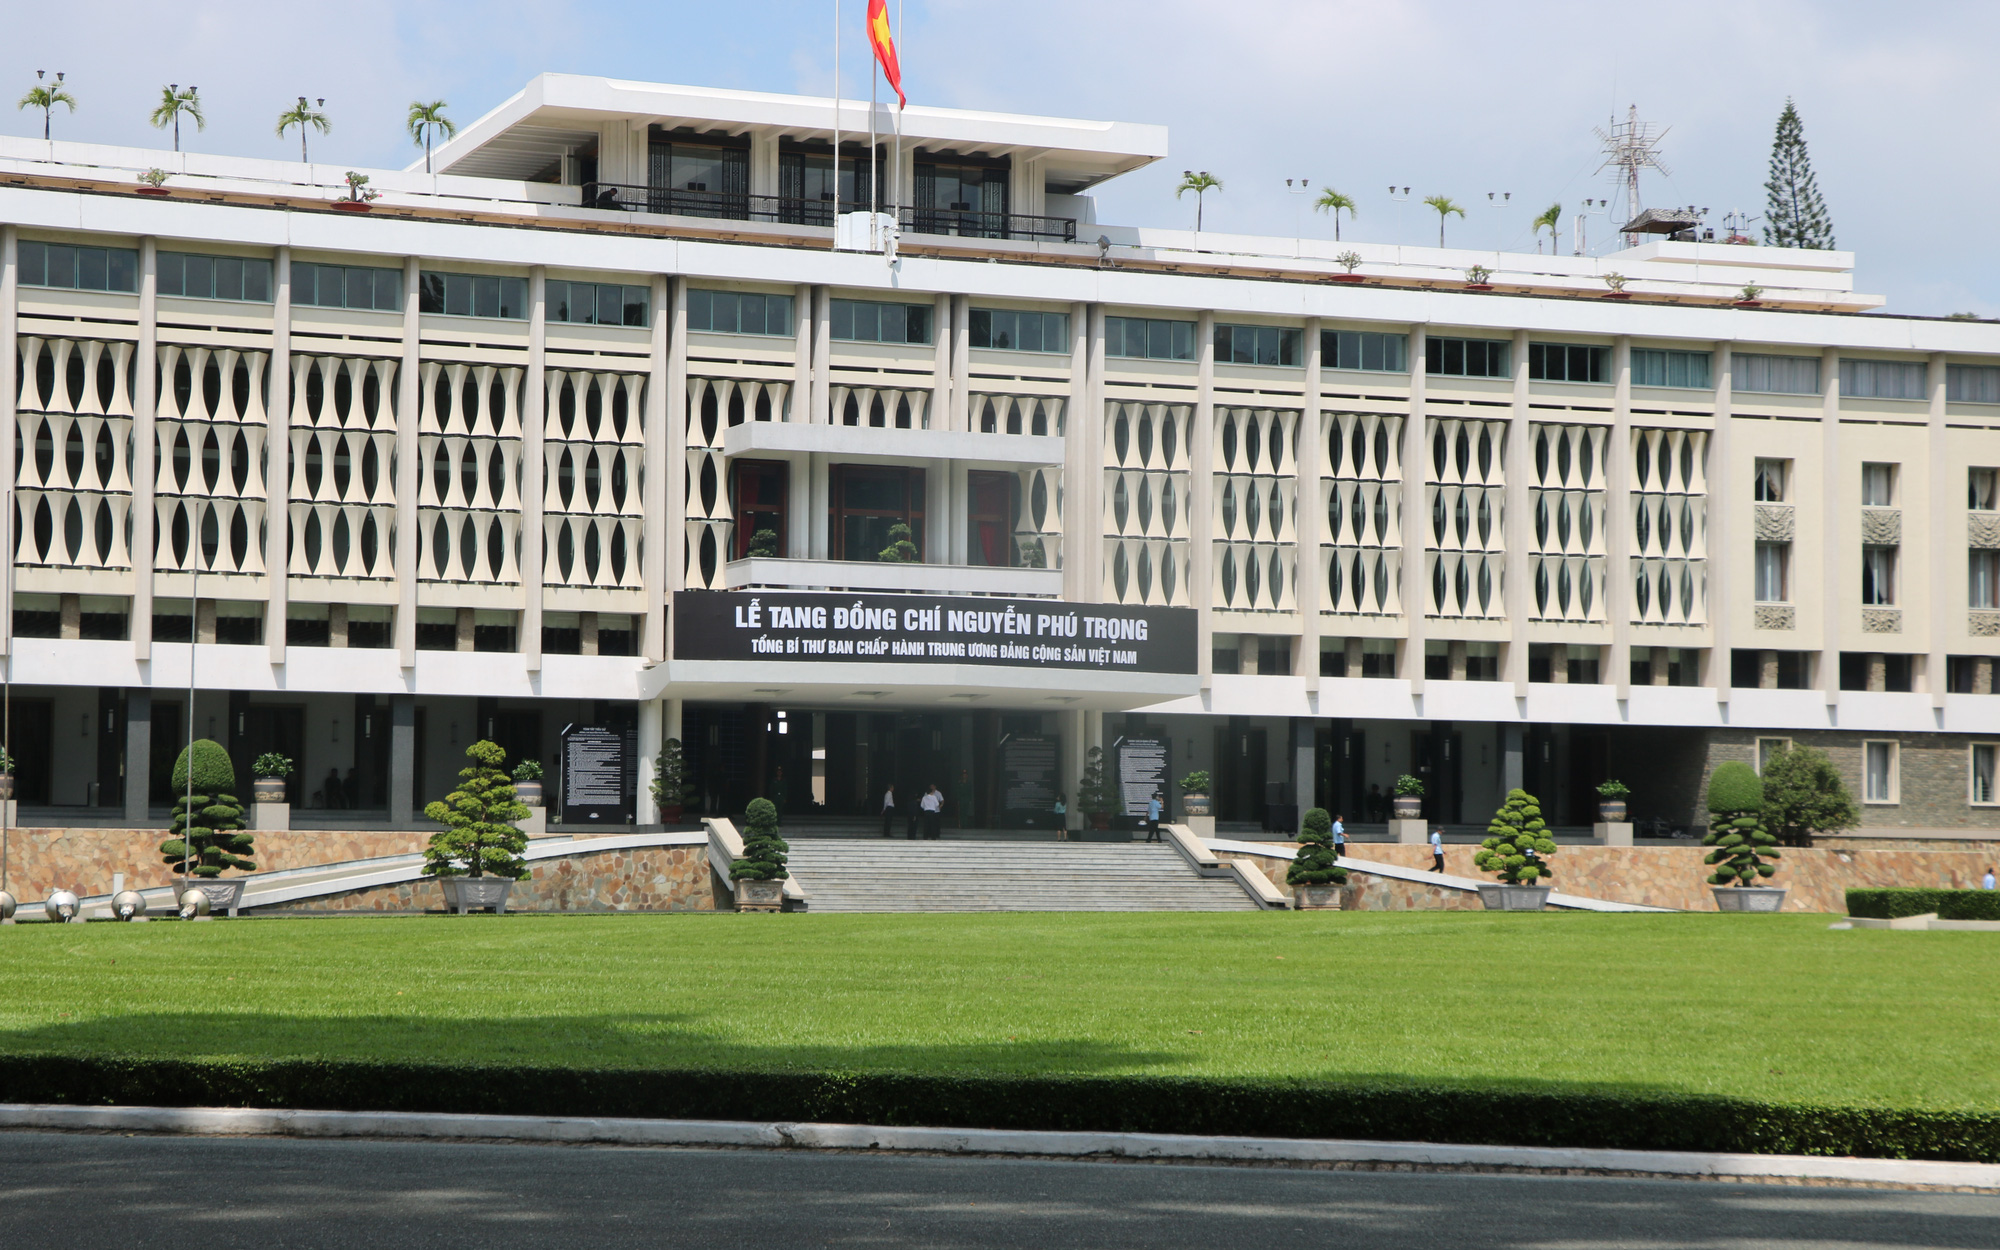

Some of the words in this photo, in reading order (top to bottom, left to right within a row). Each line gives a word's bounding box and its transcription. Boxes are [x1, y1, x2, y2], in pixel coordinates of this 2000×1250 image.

[735, 598, 762, 628] LỄ
[768, 606, 827, 629] TANG
[833, 600, 897, 630] ĐỒNG
[903, 605, 941, 631] CHÍ
[947, 604, 1032, 634] NGUYỄN
[1037, 611, 1078, 637] PHÚ
[1083, 616, 1148, 644] TRỌNG
[751, 633, 784, 654] TỔNG
[786, 636, 799, 654] BÍ
[802, 638, 827, 654] THƯ
[828, 640, 853, 655] BAN
[856, 636, 889, 655] CHẤP
[891, 639, 925, 656] HÀNH
[927, 642, 965, 657] TRUNG
[968, 642, 998, 658] ƯƠNG
[1000, 641, 1030, 660] ĐẢNG
[1032, 643, 1062, 663] CỘNG
[1064, 644, 1087, 662] SẢN
[1088, 646, 1111, 666] VIỆT
[1112, 650, 1137, 665] NAM
